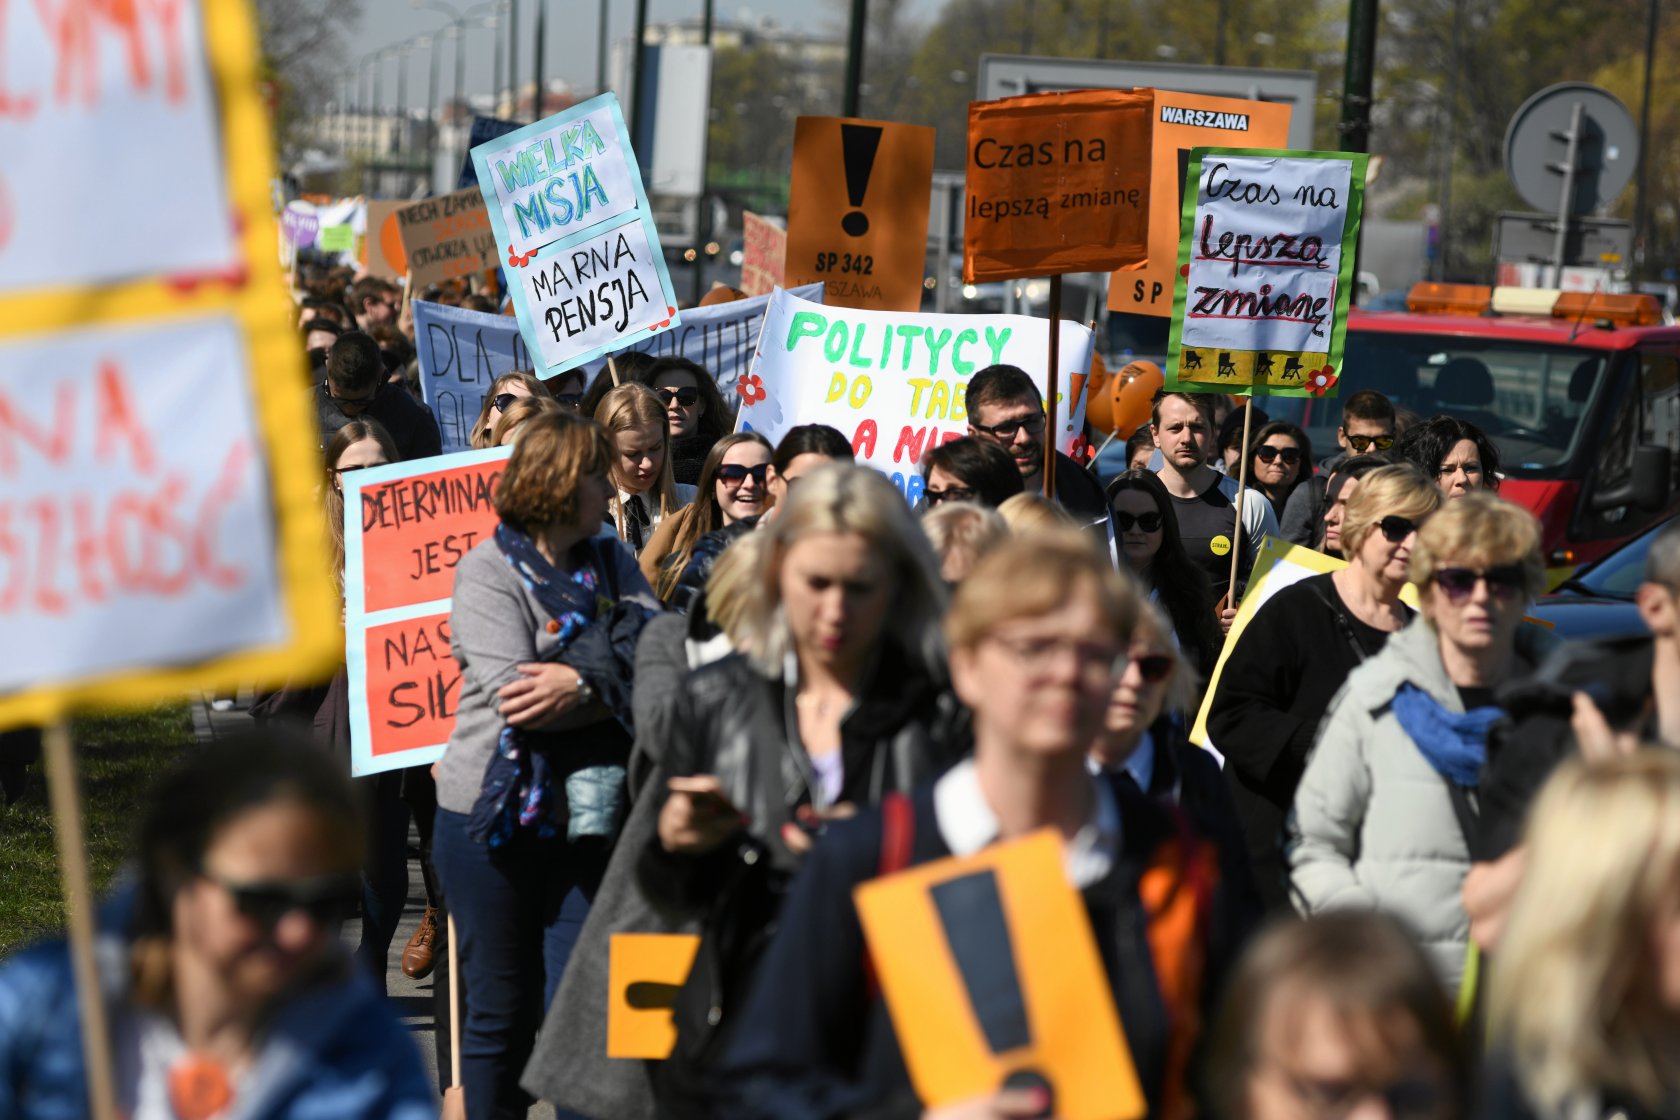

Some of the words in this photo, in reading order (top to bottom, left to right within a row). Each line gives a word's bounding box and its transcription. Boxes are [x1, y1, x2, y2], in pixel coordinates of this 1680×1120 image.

[1161, 107, 1248, 131] WARSZAWA
[495, 120, 606, 193] WIELKA
[974, 138, 1053, 168] Czas
[1064, 138, 1106, 163] na
[513, 163, 609, 240] MISJA
[970, 196, 1049, 222] lepszą
[1060, 186, 1140, 212] zmianę
[1206, 163, 1281, 206] Czas
[1293, 187, 1339, 209] na
[532, 233, 636, 302] MARNA
[815, 252, 837, 272] SP
[842, 255, 873, 275] 342
[1200, 214, 1330, 278] lepszą
[545, 269, 649, 343] PENSJA
[427, 323, 495, 384] DLA
[786, 311, 1012, 376] POLITYCY
[825, 371, 873, 410] DO
[410, 531, 478, 581] JEST
[386, 669, 463, 729] SIŁ
